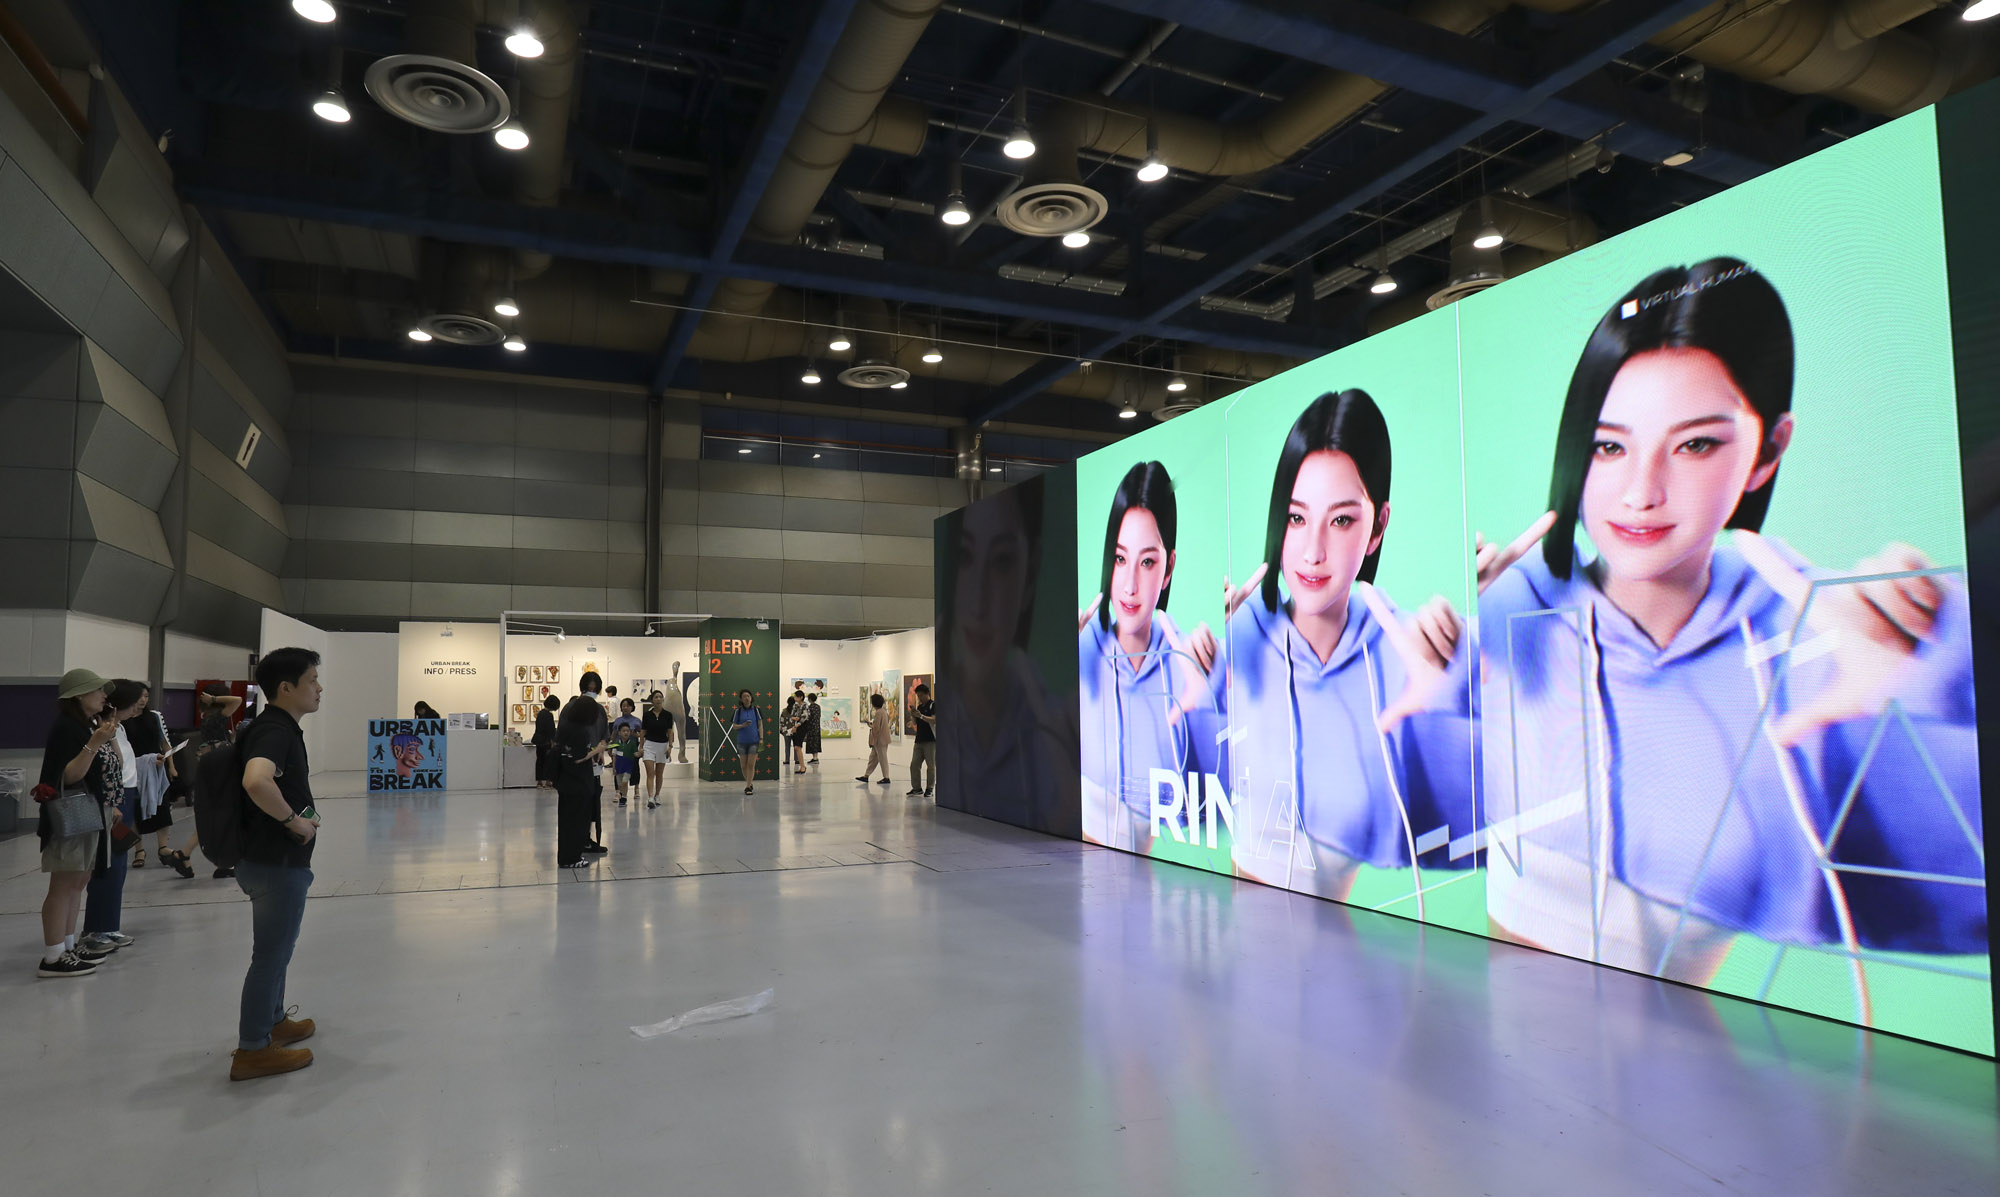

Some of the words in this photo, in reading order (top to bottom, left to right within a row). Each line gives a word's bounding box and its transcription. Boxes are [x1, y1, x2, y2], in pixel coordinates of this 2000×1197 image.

[1641, 281, 1699, 310] VIRTUAL
[370, 720, 445, 737] URBAN
[370, 772, 443, 791] BREAK
[1149, 767, 1316, 871] RINA
